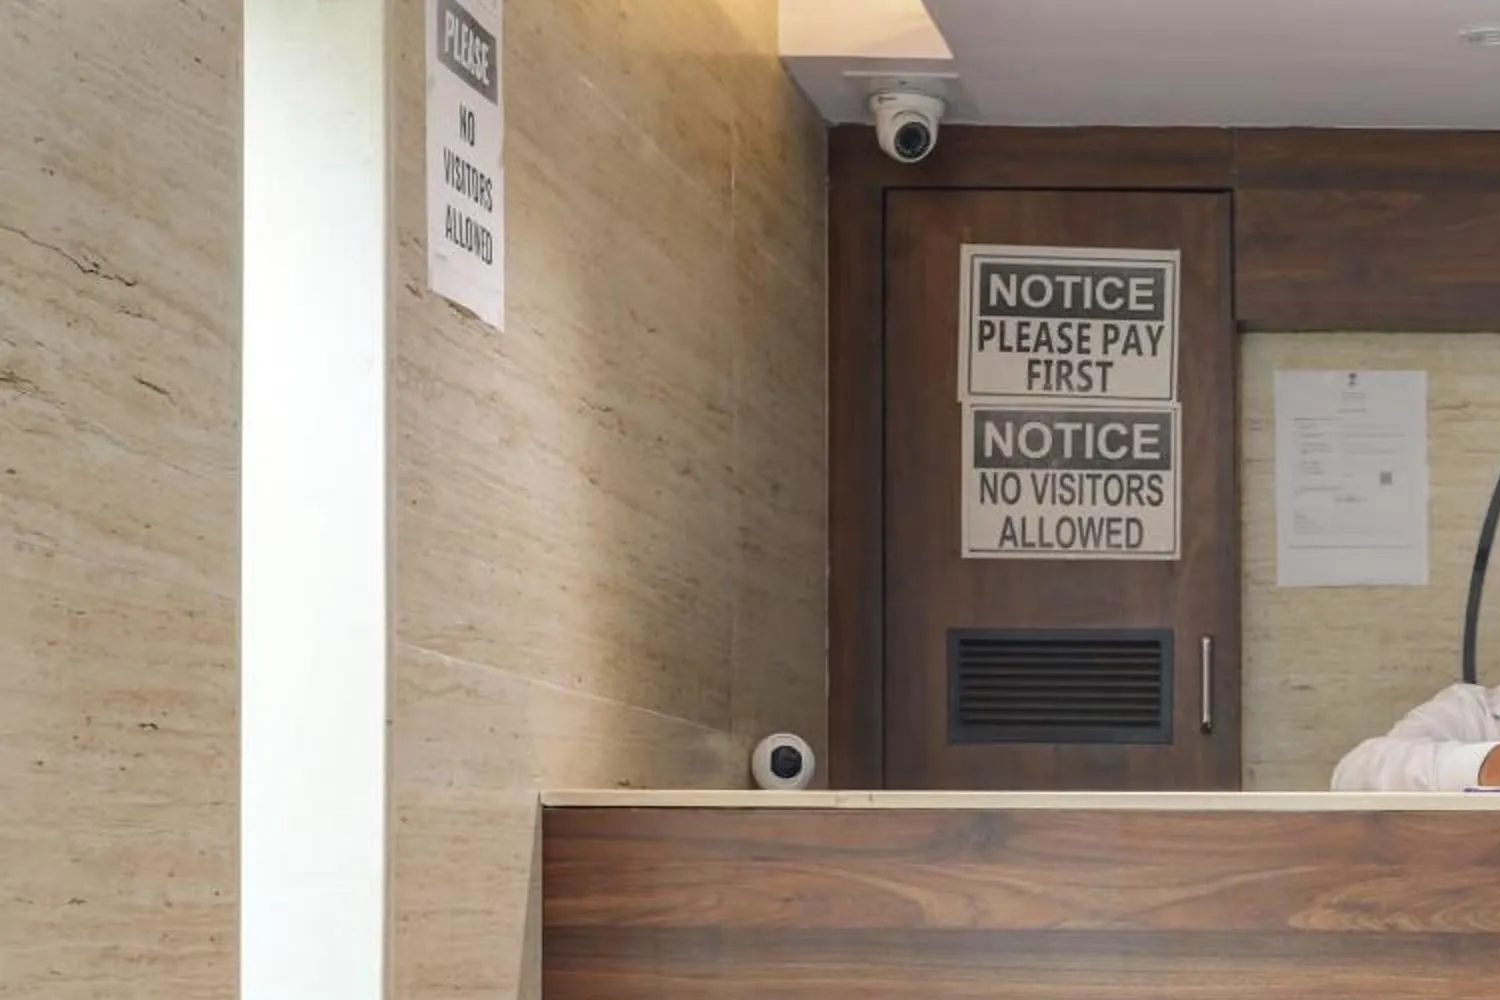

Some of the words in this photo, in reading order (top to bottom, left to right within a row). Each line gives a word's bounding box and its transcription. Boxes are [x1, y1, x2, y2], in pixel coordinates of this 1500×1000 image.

[445, 9, 490, 86] PLEASE
[459, 104, 475, 146] NO
[444, 147, 493, 212] VISITORS
[446, 204, 493, 265] ALLOWED
[987, 272, 1156, 312] NOTICE
[977, 319, 1092, 355] PLEASE
[1102, 323, 1165, 357] PAY
[1026, 359, 1114, 393] FIRST
[982, 420, 1162, 461] NOTICE
[978, 471, 1022, 506] NO
[1030, 472, 1165, 507] VISITORS
[997, 515, 1145, 549] ALLOWED
